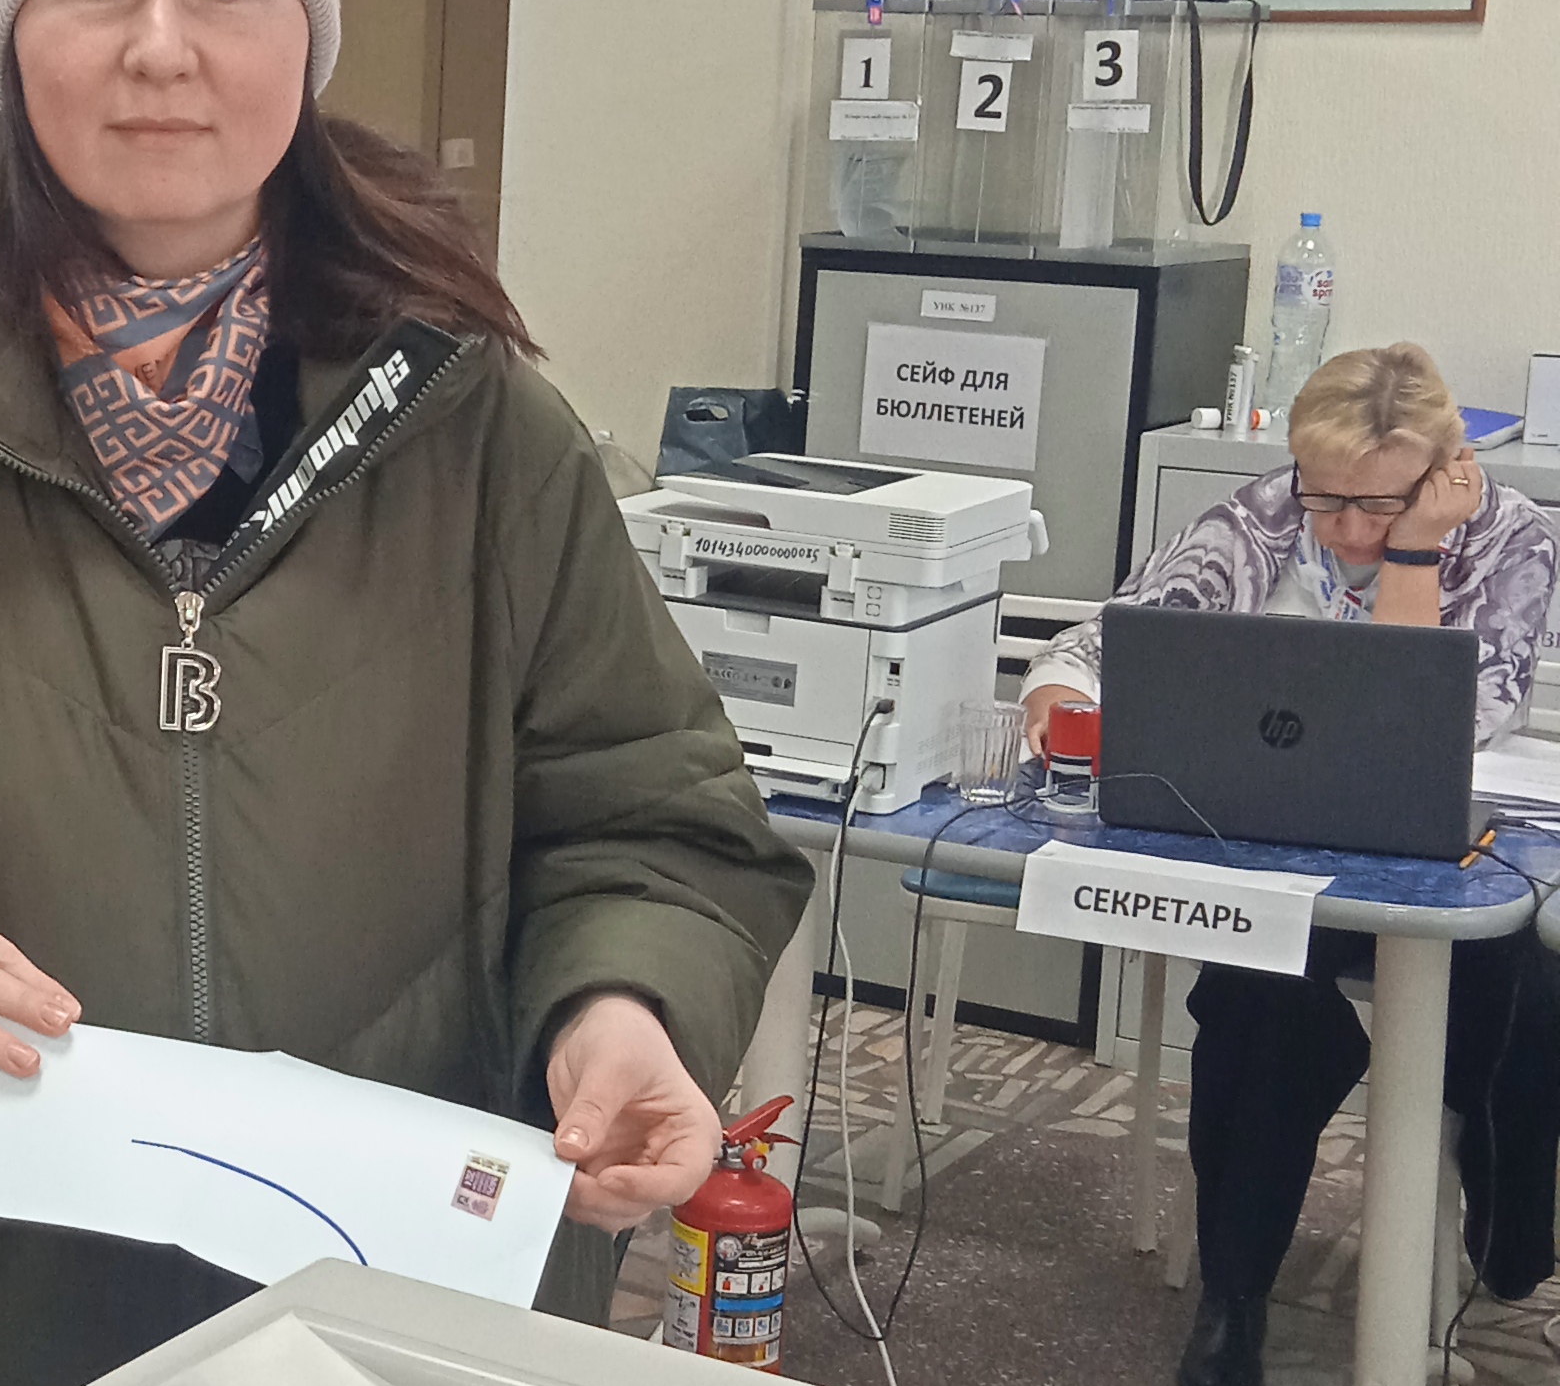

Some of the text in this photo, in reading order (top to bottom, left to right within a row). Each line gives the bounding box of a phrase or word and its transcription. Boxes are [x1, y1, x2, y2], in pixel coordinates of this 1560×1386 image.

[860, 57, 874, 89] 1
[1095, 40, 1123, 87] 3
[974, 74, 1004, 119] 2
[896, 361, 1009, 392] СЕЙФ ДЛЯ
[876, 398, 1025, 430] БЮЛЛЕТЕНЕЙ
[1262, 710, 1300, 748] hp
[1073, 885, 1253, 934] СЕКРЕТАРЬ
